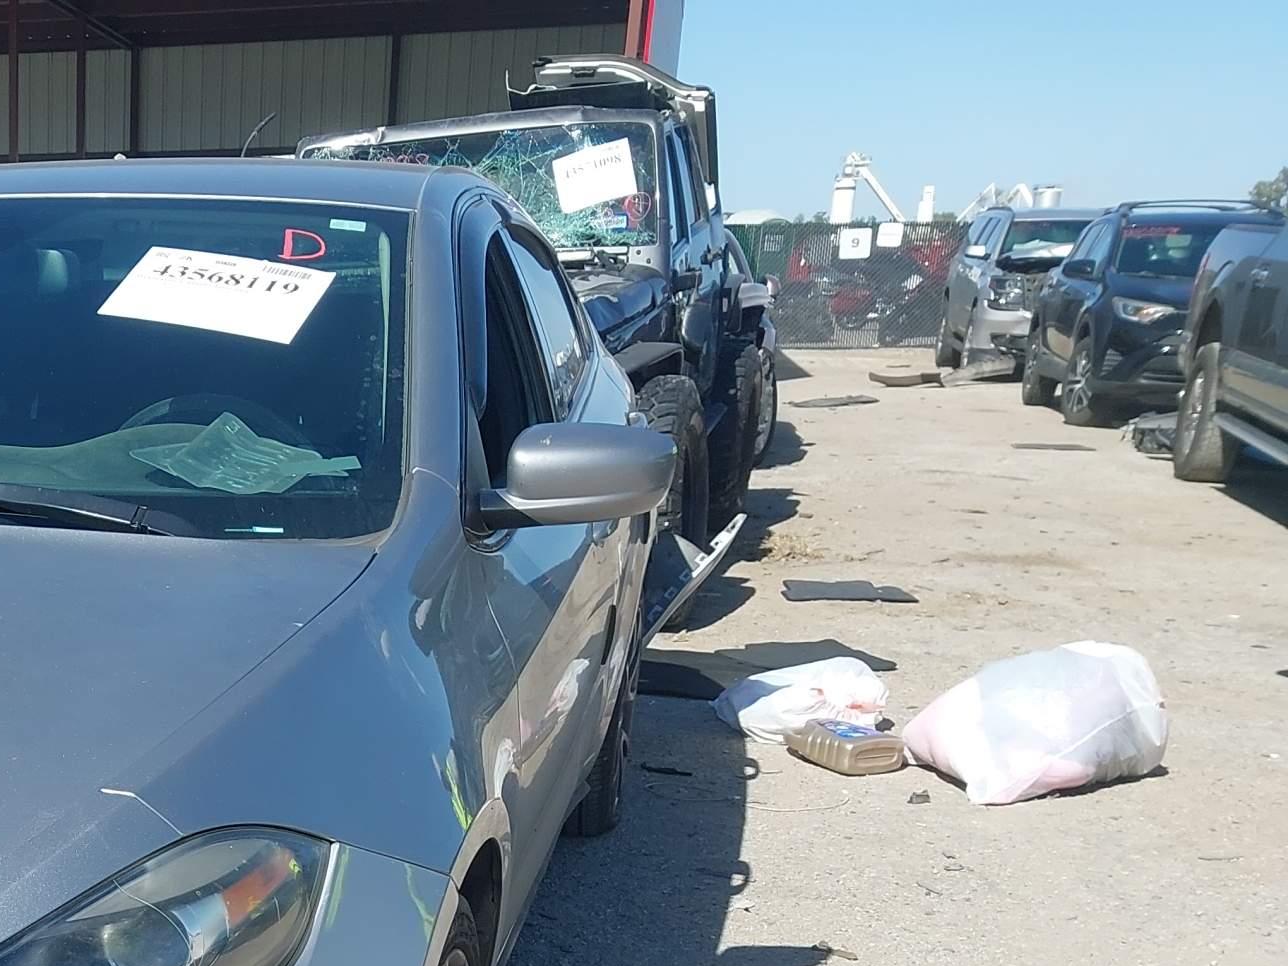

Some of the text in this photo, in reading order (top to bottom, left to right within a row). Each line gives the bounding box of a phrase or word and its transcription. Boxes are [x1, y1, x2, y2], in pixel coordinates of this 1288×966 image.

[279, 229, 326, 260] D
[851, 238, 860, 248] 9
[154, 264, 300, 295] 43568119
